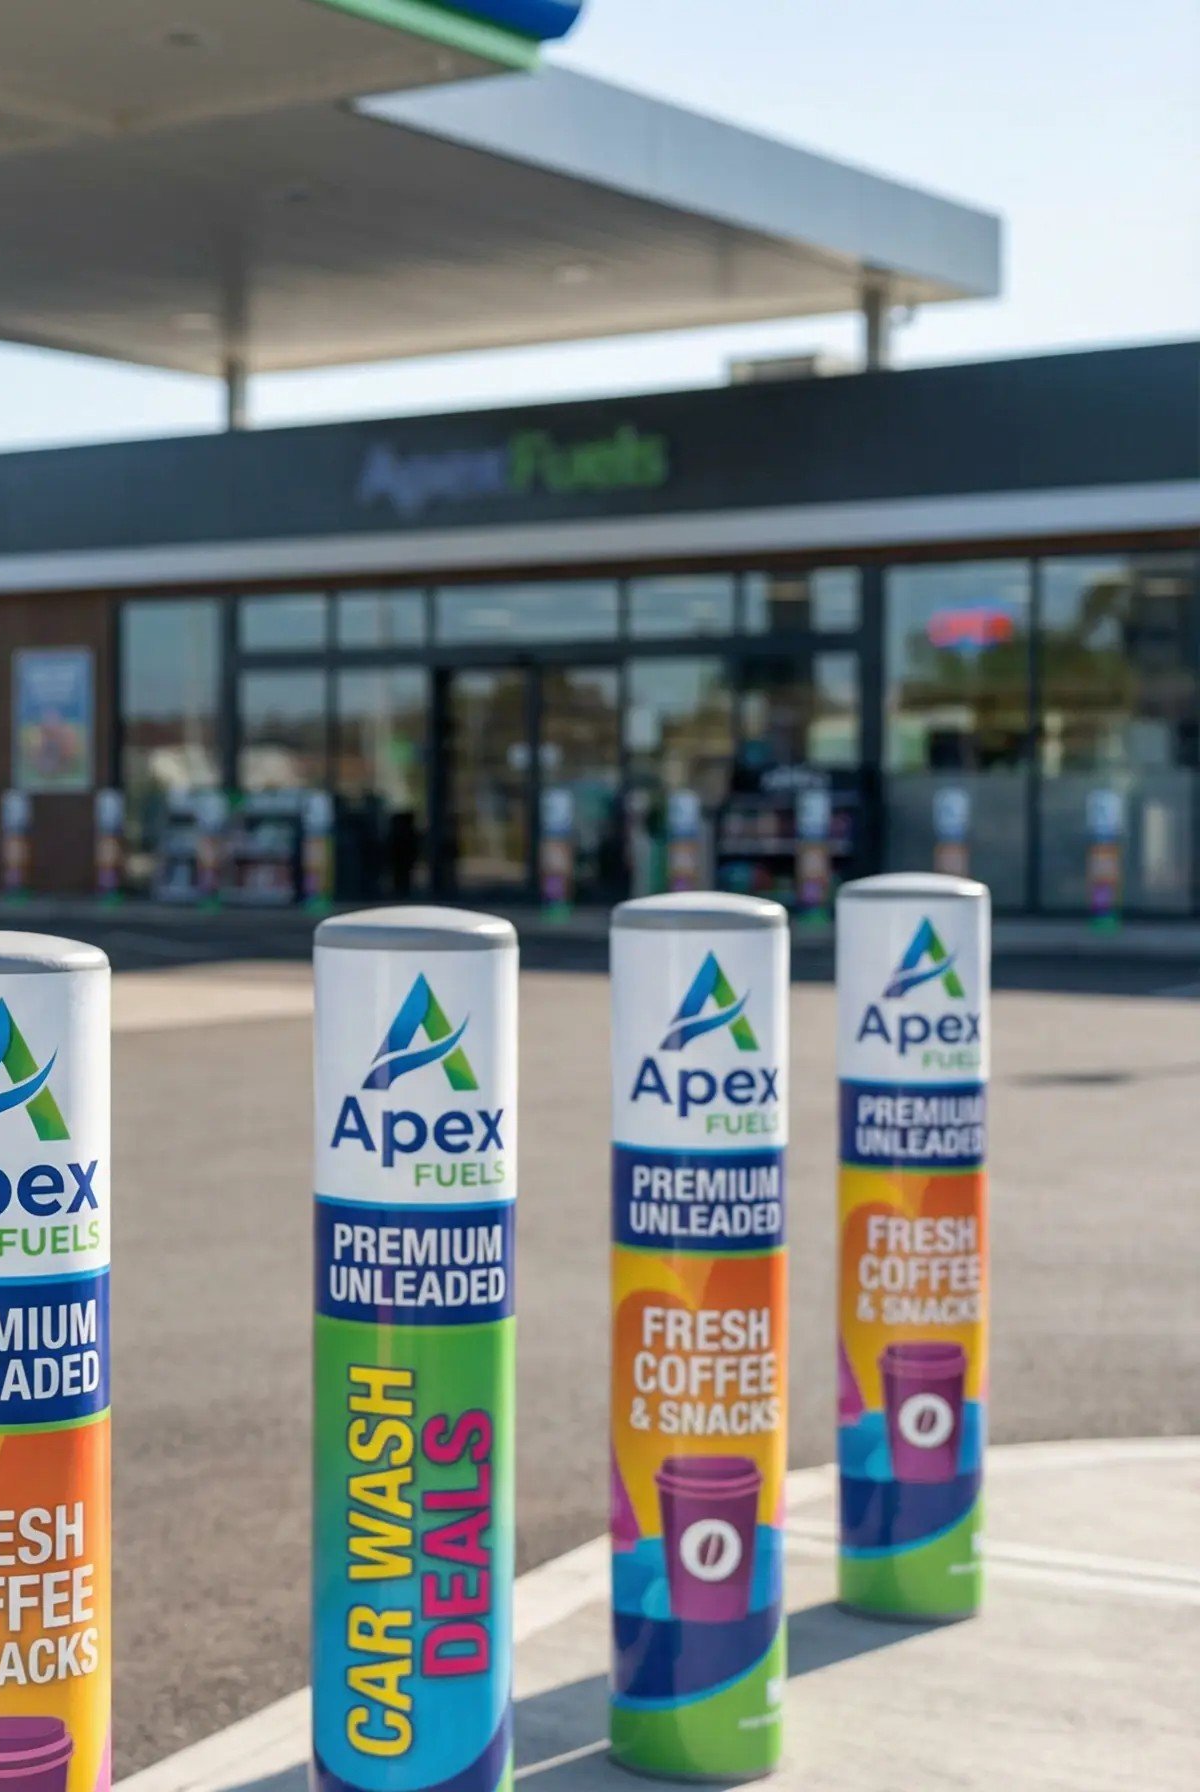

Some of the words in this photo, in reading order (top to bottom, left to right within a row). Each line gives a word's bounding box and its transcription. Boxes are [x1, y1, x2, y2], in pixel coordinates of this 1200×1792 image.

[856, 1003, 980, 1055] Apex
[630, 1056, 778, 1118] Apex
[330, 1095, 504, 1167] Apex
[415, 1161, 505, 1187] FUELS
[632, 1165, 779, 1202] PREMIUM
[629, 1201, 782, 1238] UNLEADED
[867, 1214, 977, 1254] FRESH
[334, 1223, 503, 1266] PREMIUM
[330, 1265, 506, 1307] UNLEADED
[858, 1253, 980, 1293] COFFEE
[642, 1306, 770, 1352] FRESH
[634, 1351, 777, 1398] COFFEE
[630, 1396, 651, 1431] &
[658, 1396, 781, 1435] SNACKS
[347, 1364, 415, 1581] WASH
[421, 1408, 494, 1678] DEALS
[347, 1604, 415, 1757] CAR
